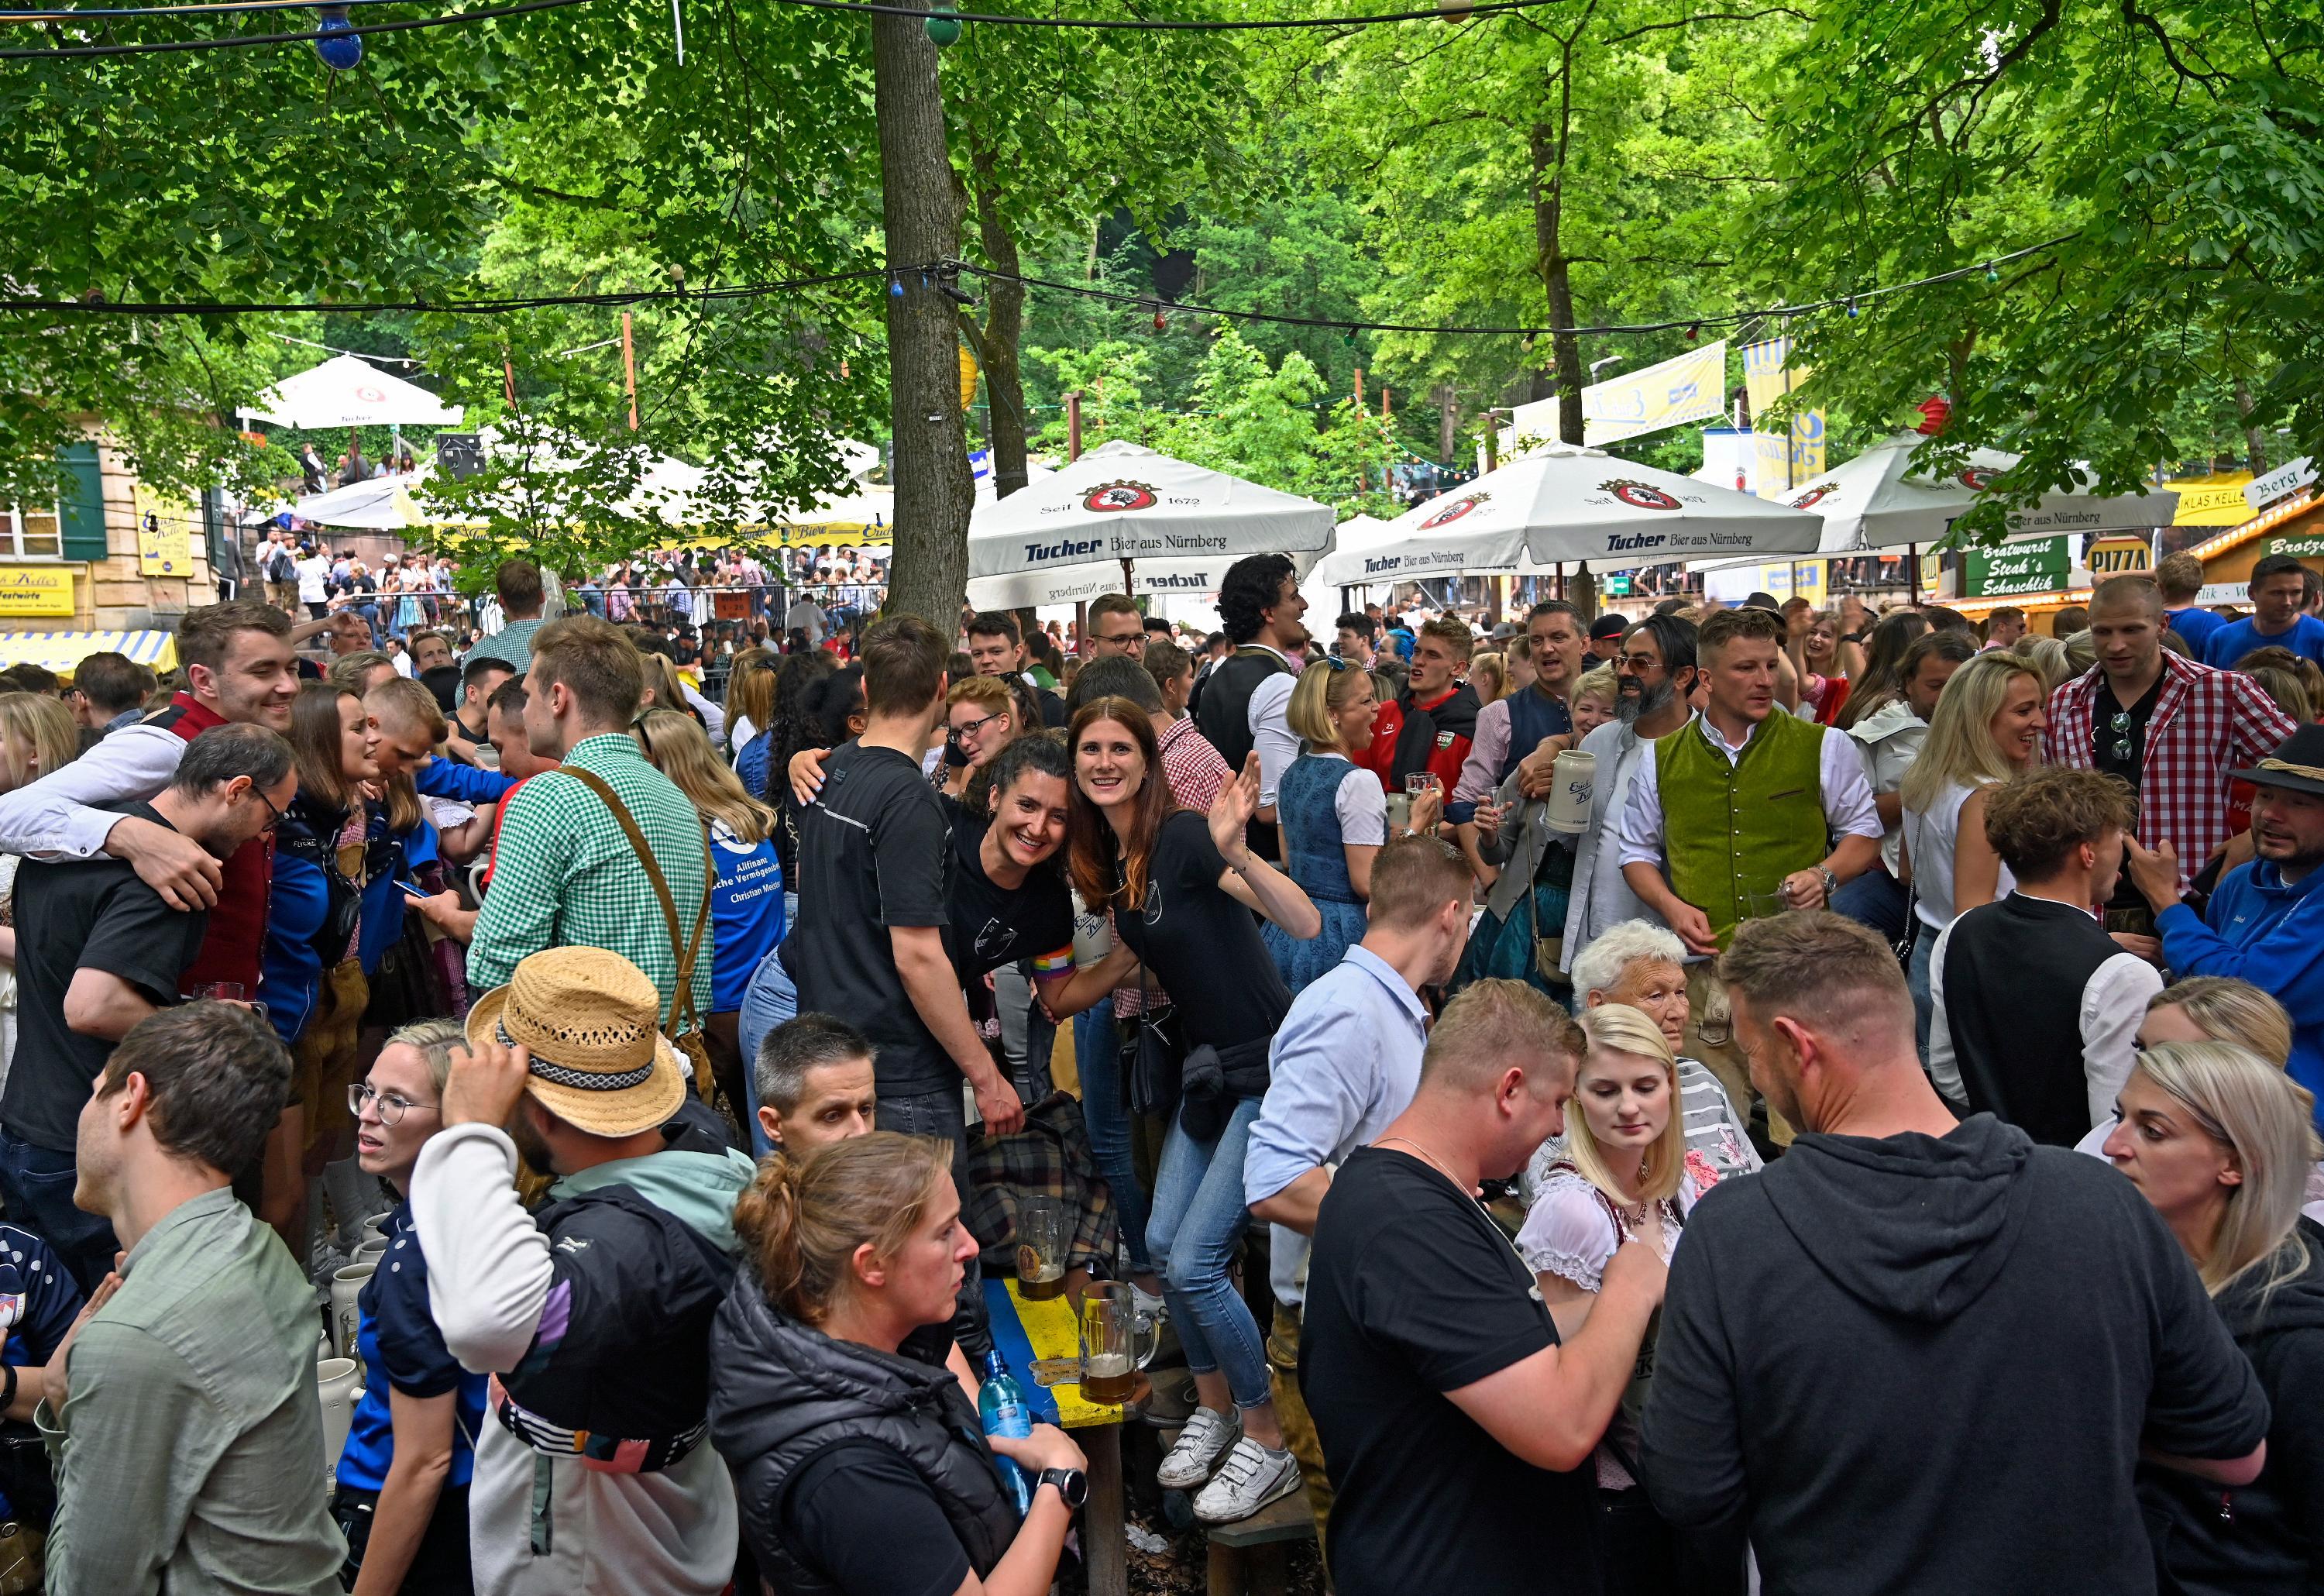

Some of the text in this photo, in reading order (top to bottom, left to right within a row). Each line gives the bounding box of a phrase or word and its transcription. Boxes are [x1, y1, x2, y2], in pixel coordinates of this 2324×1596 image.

[1926, 483, 1956, 491] Seit
[2255, 470, 2298, 500] Berg
[1040, 497, 1200, 514] Seit 1672
[1584, 497, 1614, 506] Seit
[2176, 491, 2245, 510] IKLAS KELLE
[2034, 517, 2051, 525] aus
[2054, 511, 2101, 524] Nürnberg
[796, 525, 827, 540] Biere
[1025, 535, 1227, 562] Tucher Bier aus Nürnberg
[1607, 533, 1752, 551] Tucher Bier aus Nürnberg
[1982, 539, 2052, 559] Bratwurst
[1364, 551, 1464, 573] Tucher Bier aus Nürnberg
[2092, 549, 2147, 574] PIZZA
[1982, 575, 2052, 596] Schaschlik
[0, 590, 40, 600] estwirte
[737, 857, 768, 872] Allfinanz
[731, 888, 762, 903] Christian
